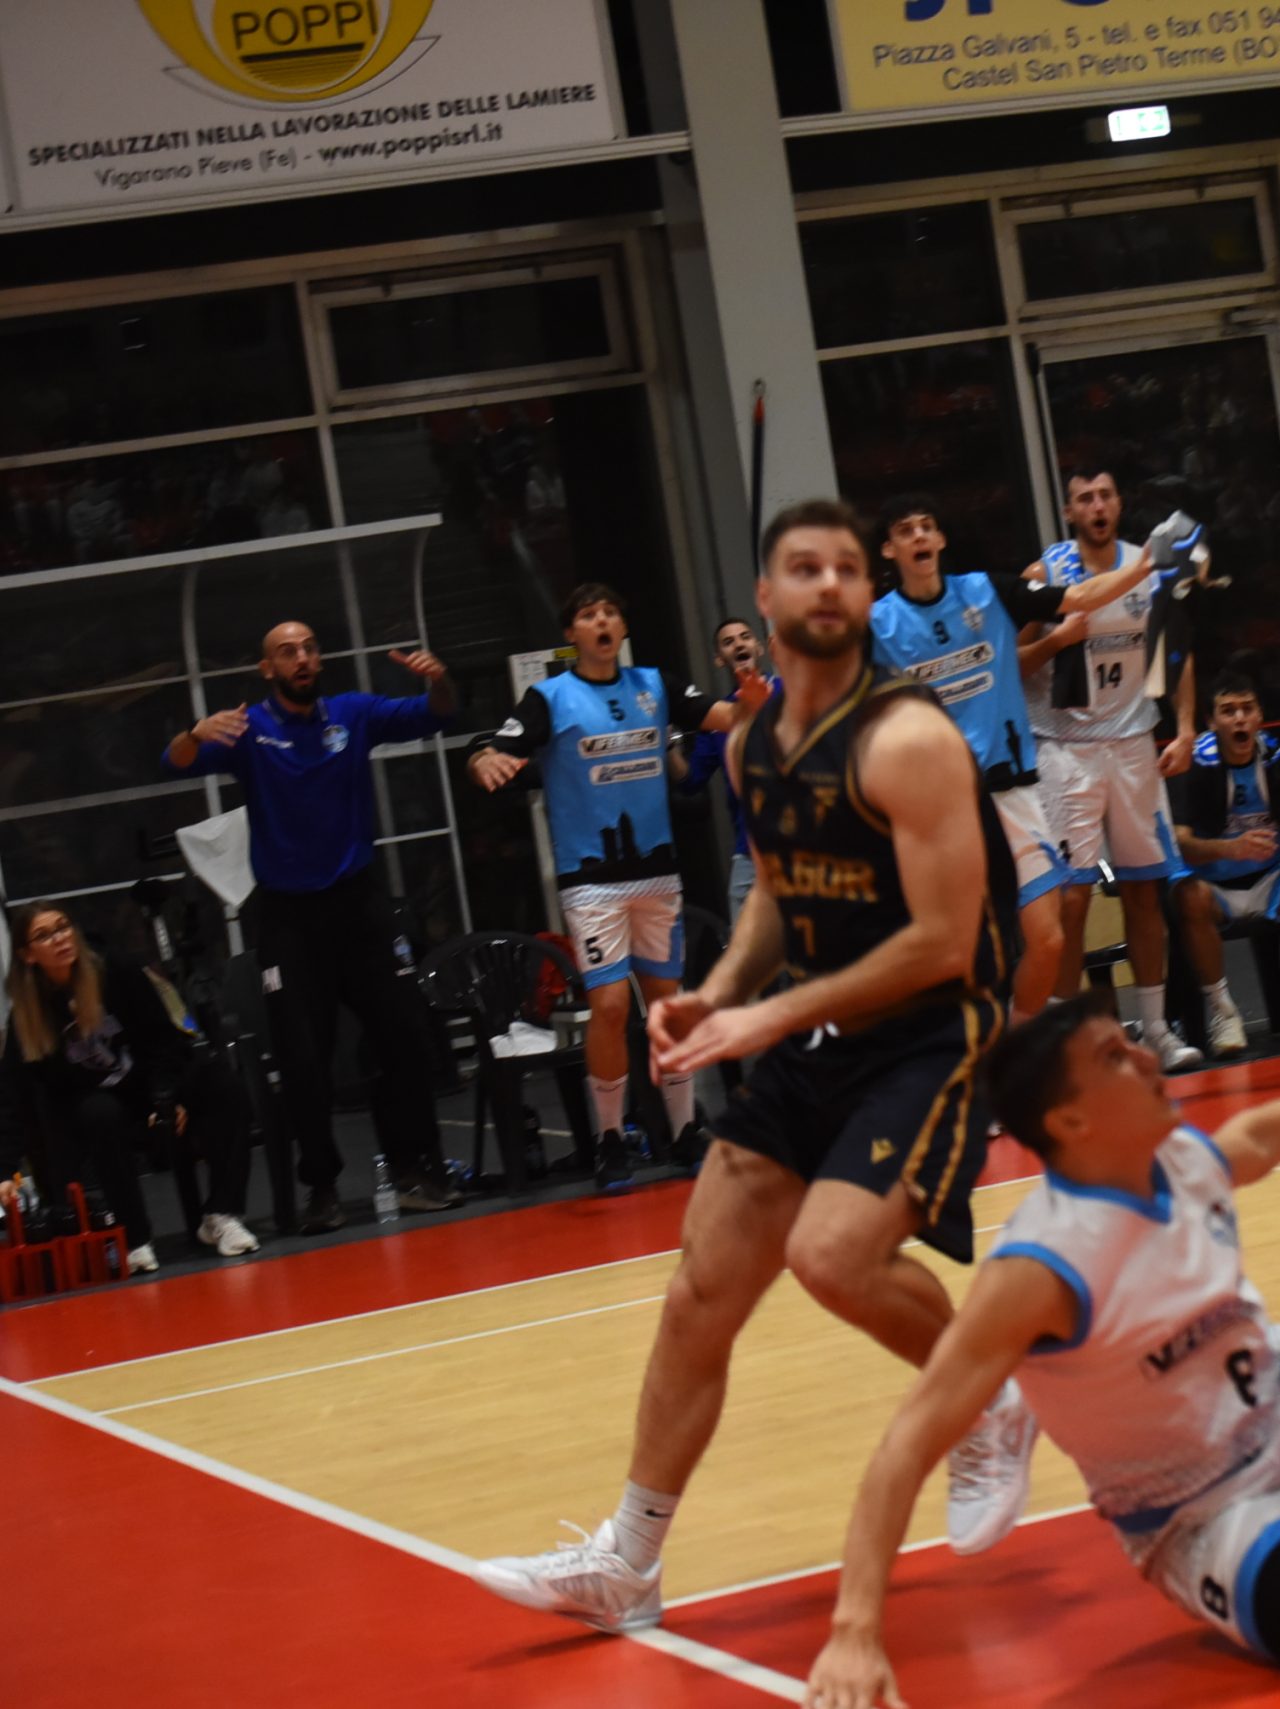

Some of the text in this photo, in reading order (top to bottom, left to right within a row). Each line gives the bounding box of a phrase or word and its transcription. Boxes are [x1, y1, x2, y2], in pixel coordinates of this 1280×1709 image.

[231, 0, 377, 50] POPPI
[873, 43, 955, 67] Piazza
[1065, 26, 1081, 49] 5
[1144, 24, 1160, 41] e
[1166, 15, 1201, 38] fax
[1208, 10, 1250, 34] 051
[943, 62, 1019, 90] Castel
[1025, 58, 1072, 82] San
[1078, 53, 1148, 77] Pietro
[1152, 46, 1226, 68] Terme
[28, 83, 597, 166] SPECIALIZZATI NELLA LAVORAZIONE DELLE LAMIERE
[95, 164, 192, 190] Vigarano
[198, 155, 253, 177] Pieve
[258, 147, 298, 173] (Fe)
[317, 122, 504, 163] www.poppisrl.it
[1095, 661, 1123, 690] 14
[607, 698, 626, 721] 5
[584, 936, 604, 965] 5
[792, 916, 816, 958] 7
